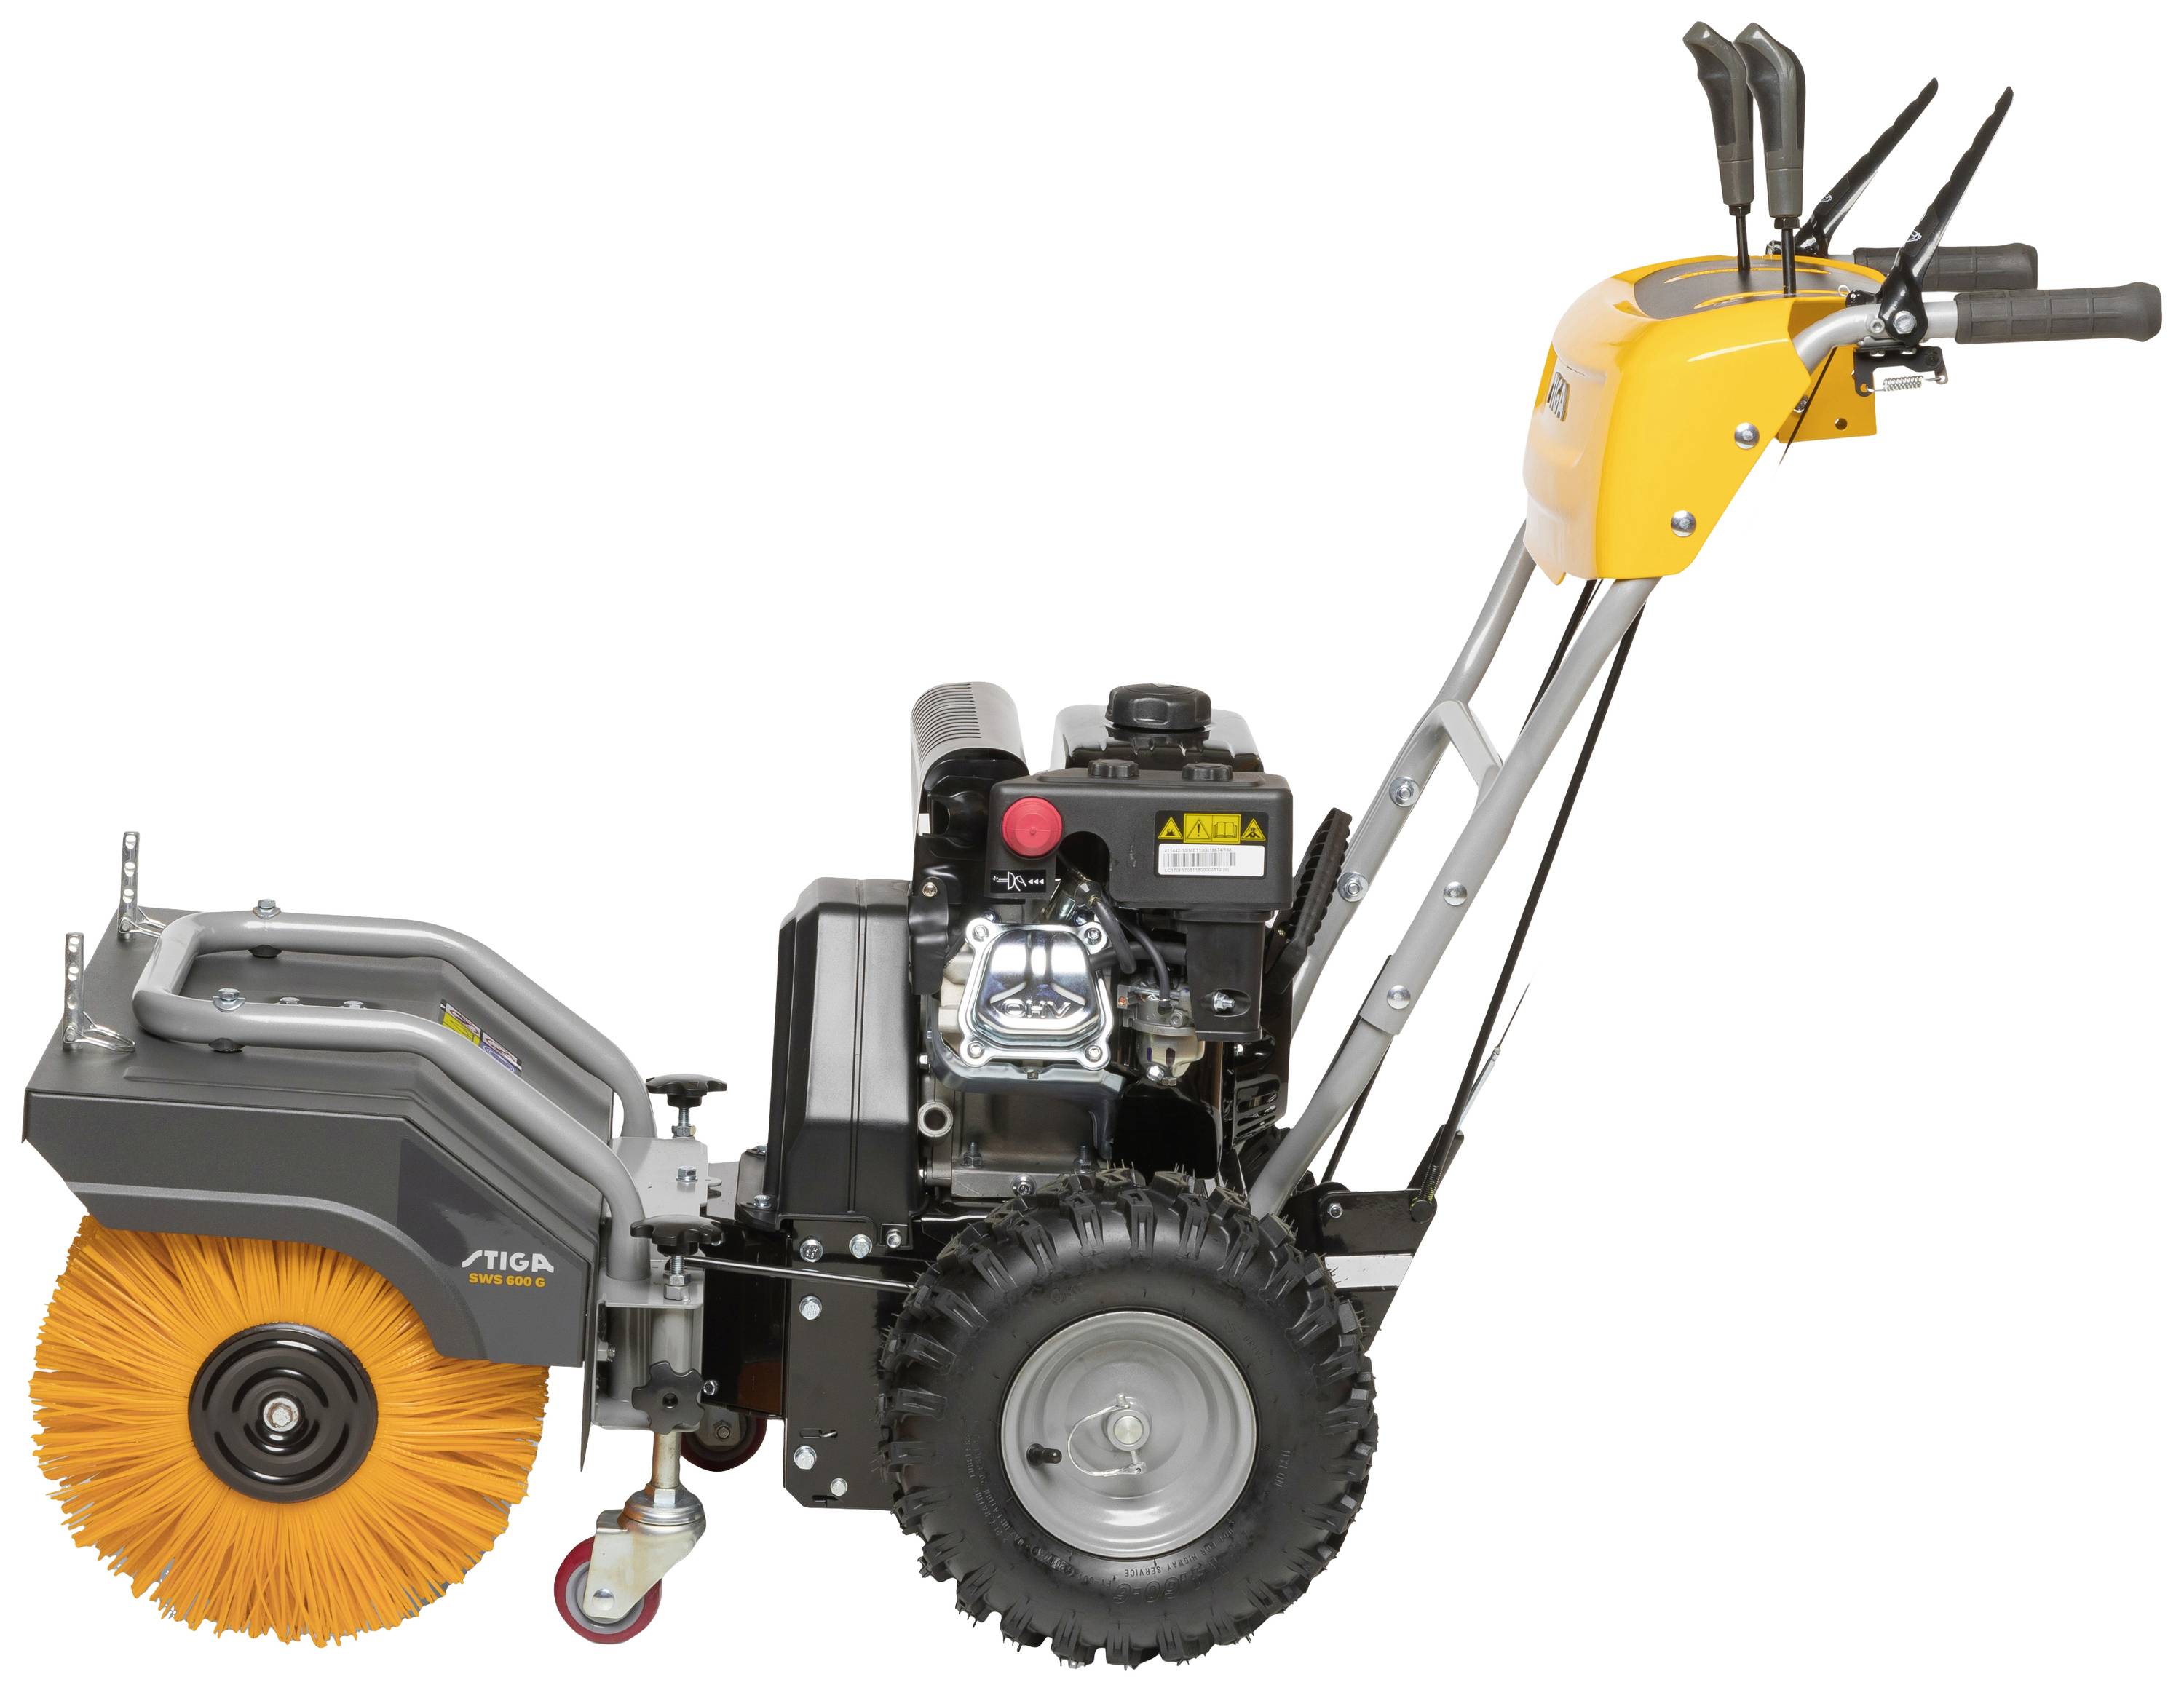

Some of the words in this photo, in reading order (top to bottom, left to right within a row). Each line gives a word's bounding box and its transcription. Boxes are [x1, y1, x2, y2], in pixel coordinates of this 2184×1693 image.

[1002, 999, 1070, 1018] OHV
[462, 1250, 554, 1273] STIGA
[468, 1272, 503, 1285] SWS
[506, 1275, 532, 1287] 600
[535, 1277, 545, 1288] G
[1124, 1565, 1162, 1577] SERVICE
[1166, 1553, 1198, 1571] HIGWAY
